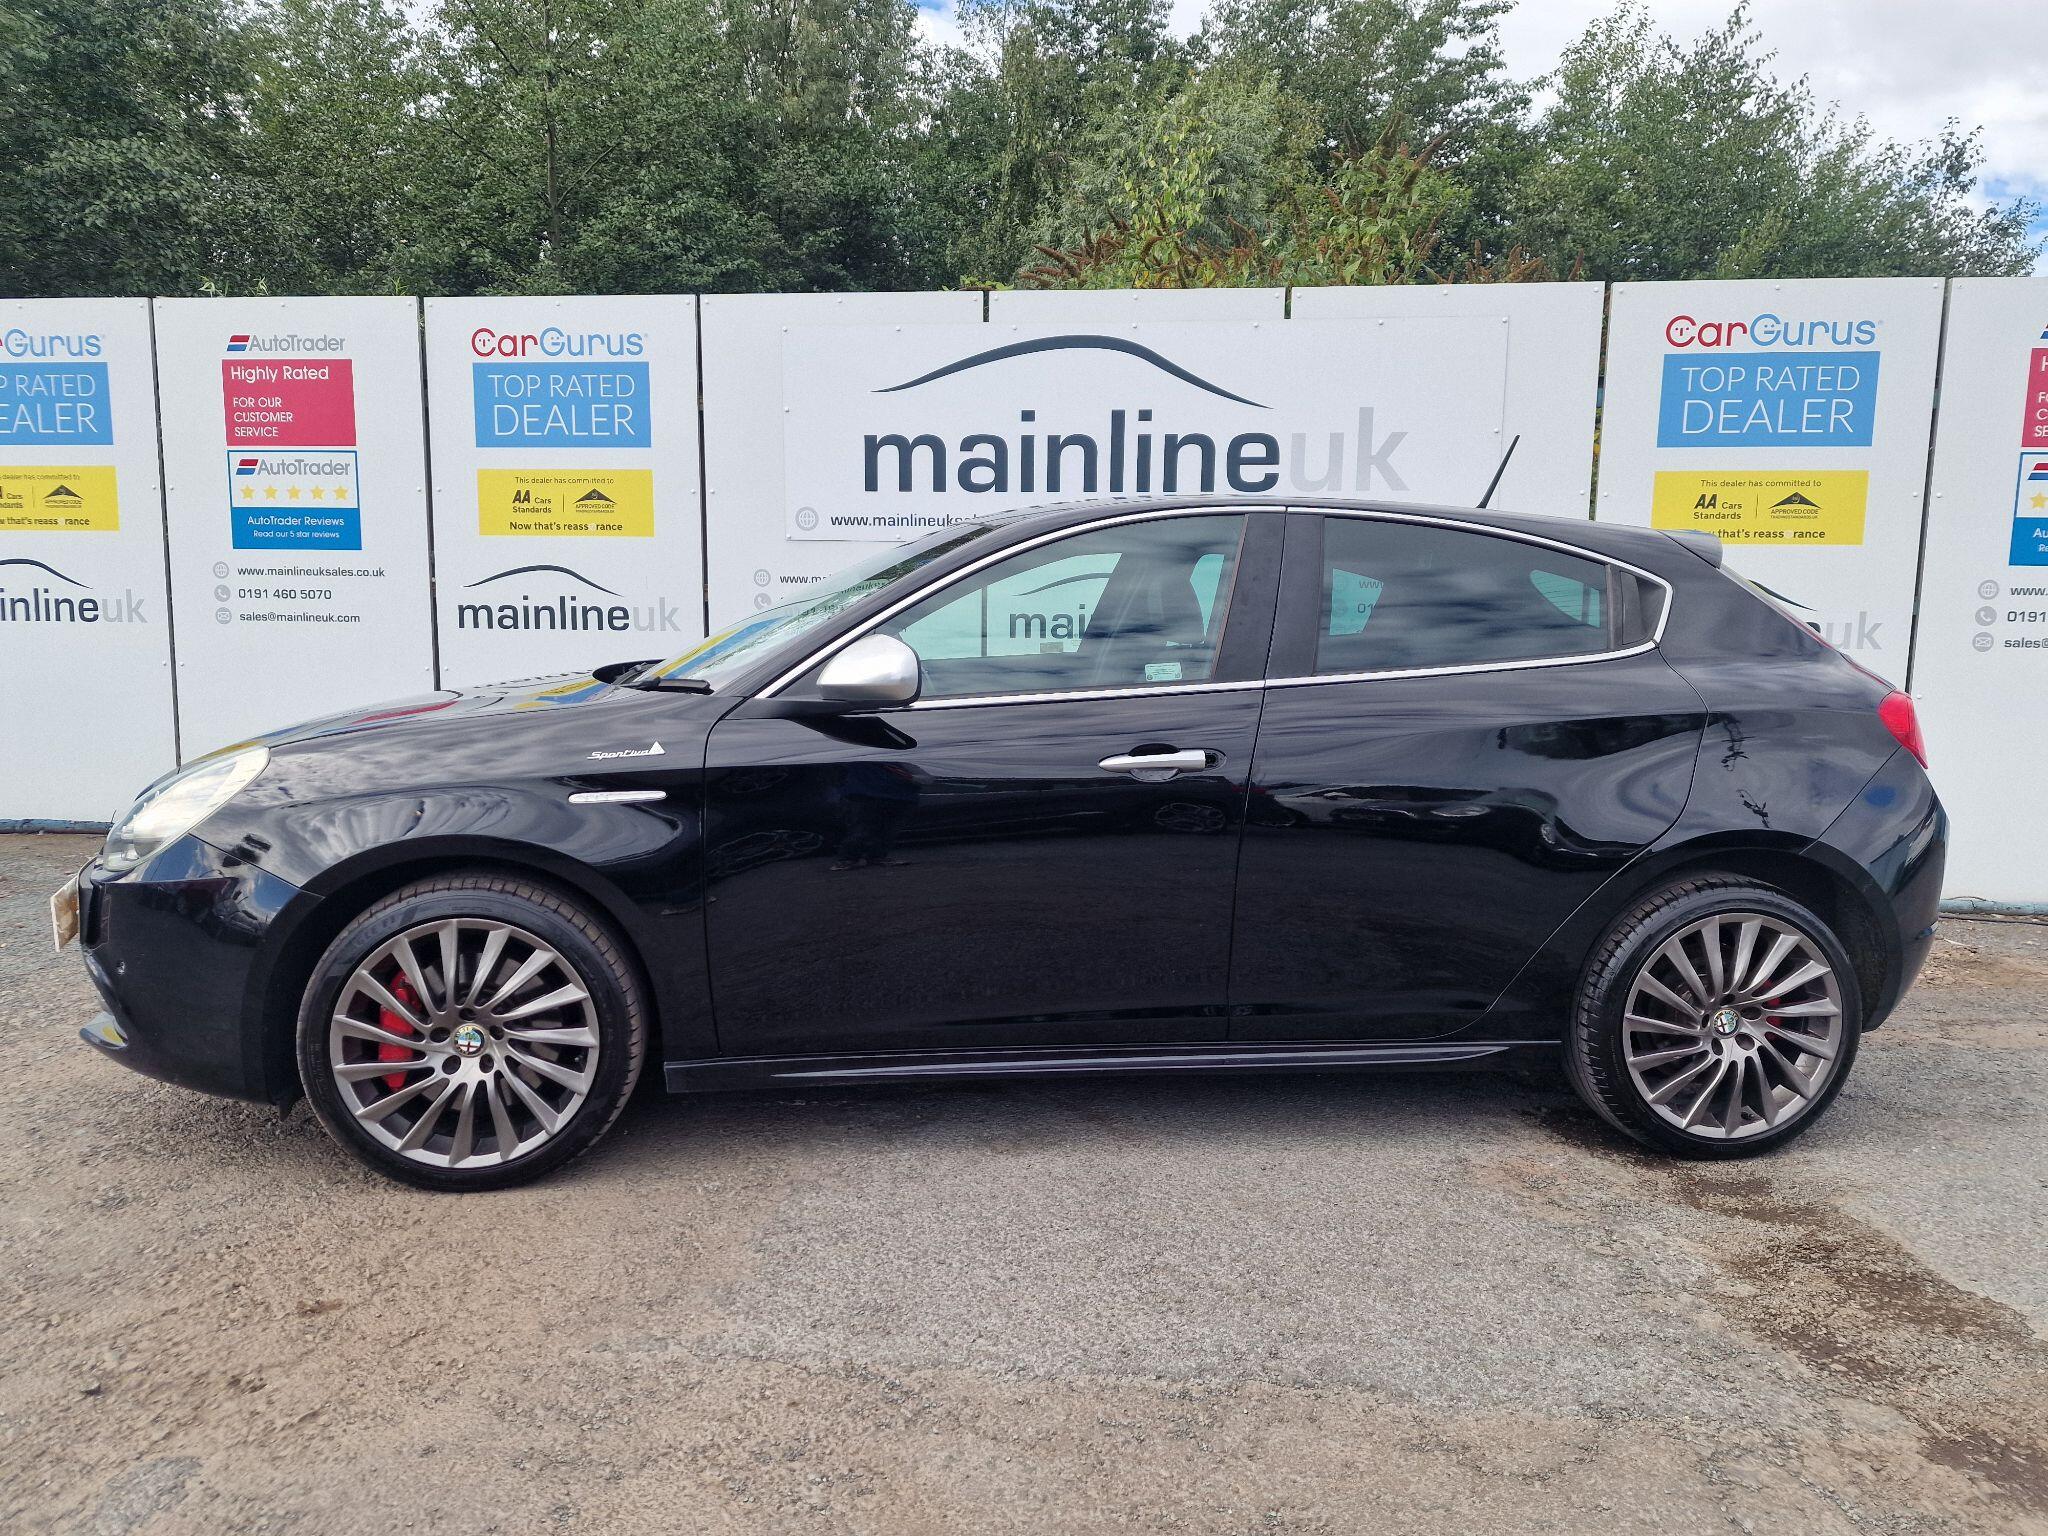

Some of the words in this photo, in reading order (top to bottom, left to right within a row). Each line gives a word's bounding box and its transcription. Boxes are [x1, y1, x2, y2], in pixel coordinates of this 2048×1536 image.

[1665, 313, 1876, 347] CarGurus
[0, 328, 101, 358] Gurus
[249, 334, 346, 351] AutoTrader
[471, 327, 644, 357] CarGurus
[231, 365, 278, 383] Highly
[283, 365, 329, 380] Rated
[1680, 366, 1746, 392] TOP
[1756, 366, 1860, 391] RATED
[15, 374, 96, 397] RATED
[488, 374, 540, 398] TOP
[550, 374, 635, 398] RATED
[233, 397, 255, 408] FOR
[258, 397, 282, 408] OUR
[234, 411, 293, 423] CUSTOMER
[493, 403, 635, 436] DEALER
[1681, 398, 1854, 434] DEALER
[234, 426, 279, 437] SERVICE
[863, 406, 1411, 493] mainlineuk
[257, 458, 351, 475] AutoTrader
[515, 476, 530, 484] This
[531, 476, 552, 484] dealer
[554, 476, 567, 484] has
[568, 476, 606, 485] committed
[607, 477, 615, 485] to
[1701, 479, 1718, 487] This
[1720, 479, 1746, 487] dealer
[1748, 479, 1763, 487] has
[1765, 479, 1811, 487] committed
[1813, 479, 1822, 487] to
[512, 489, 531, 504] AA
[534, 497, 551, 505] Cars
[1694, 493, 1718, 509] AA
[1721, 501, 1743, 510] Cars
[512, 505, 552, 514] Standards
[1693, 511, 1742, 520] Standards
[34, 518, 90, 526] reassrance
[247, 515, 301, 526] AutoTrader
[304, 516, 345, 526] Reviews
[509, 521, 532, 530] Now
[534, 521, 561, 531] that's
[563, 522, 623, 531] reassrance
[253, 529, 274, 538] Read
[290, 530, 295, 538] 5
[296, 530, 310, 538] star
[311, 531, 340, 539] reviews
[1718, 528, 1750, 539] that's
[1753, 530, 1826, 539] reassrance
[237, 566, 386, 577] www.mainlineuksales.co.uk
[238, 588, 269, 599] 0191
[273, 588, 297, 599] 460
[300, 589, 332, 600] 5070
[239, 611, 361, 624] sales@mainlineuk.com
[457, 595, 682, 633] mainlineuk
[1009, 603, 1093, 639] mai
[2007, 611, 2047, 623] 0191
